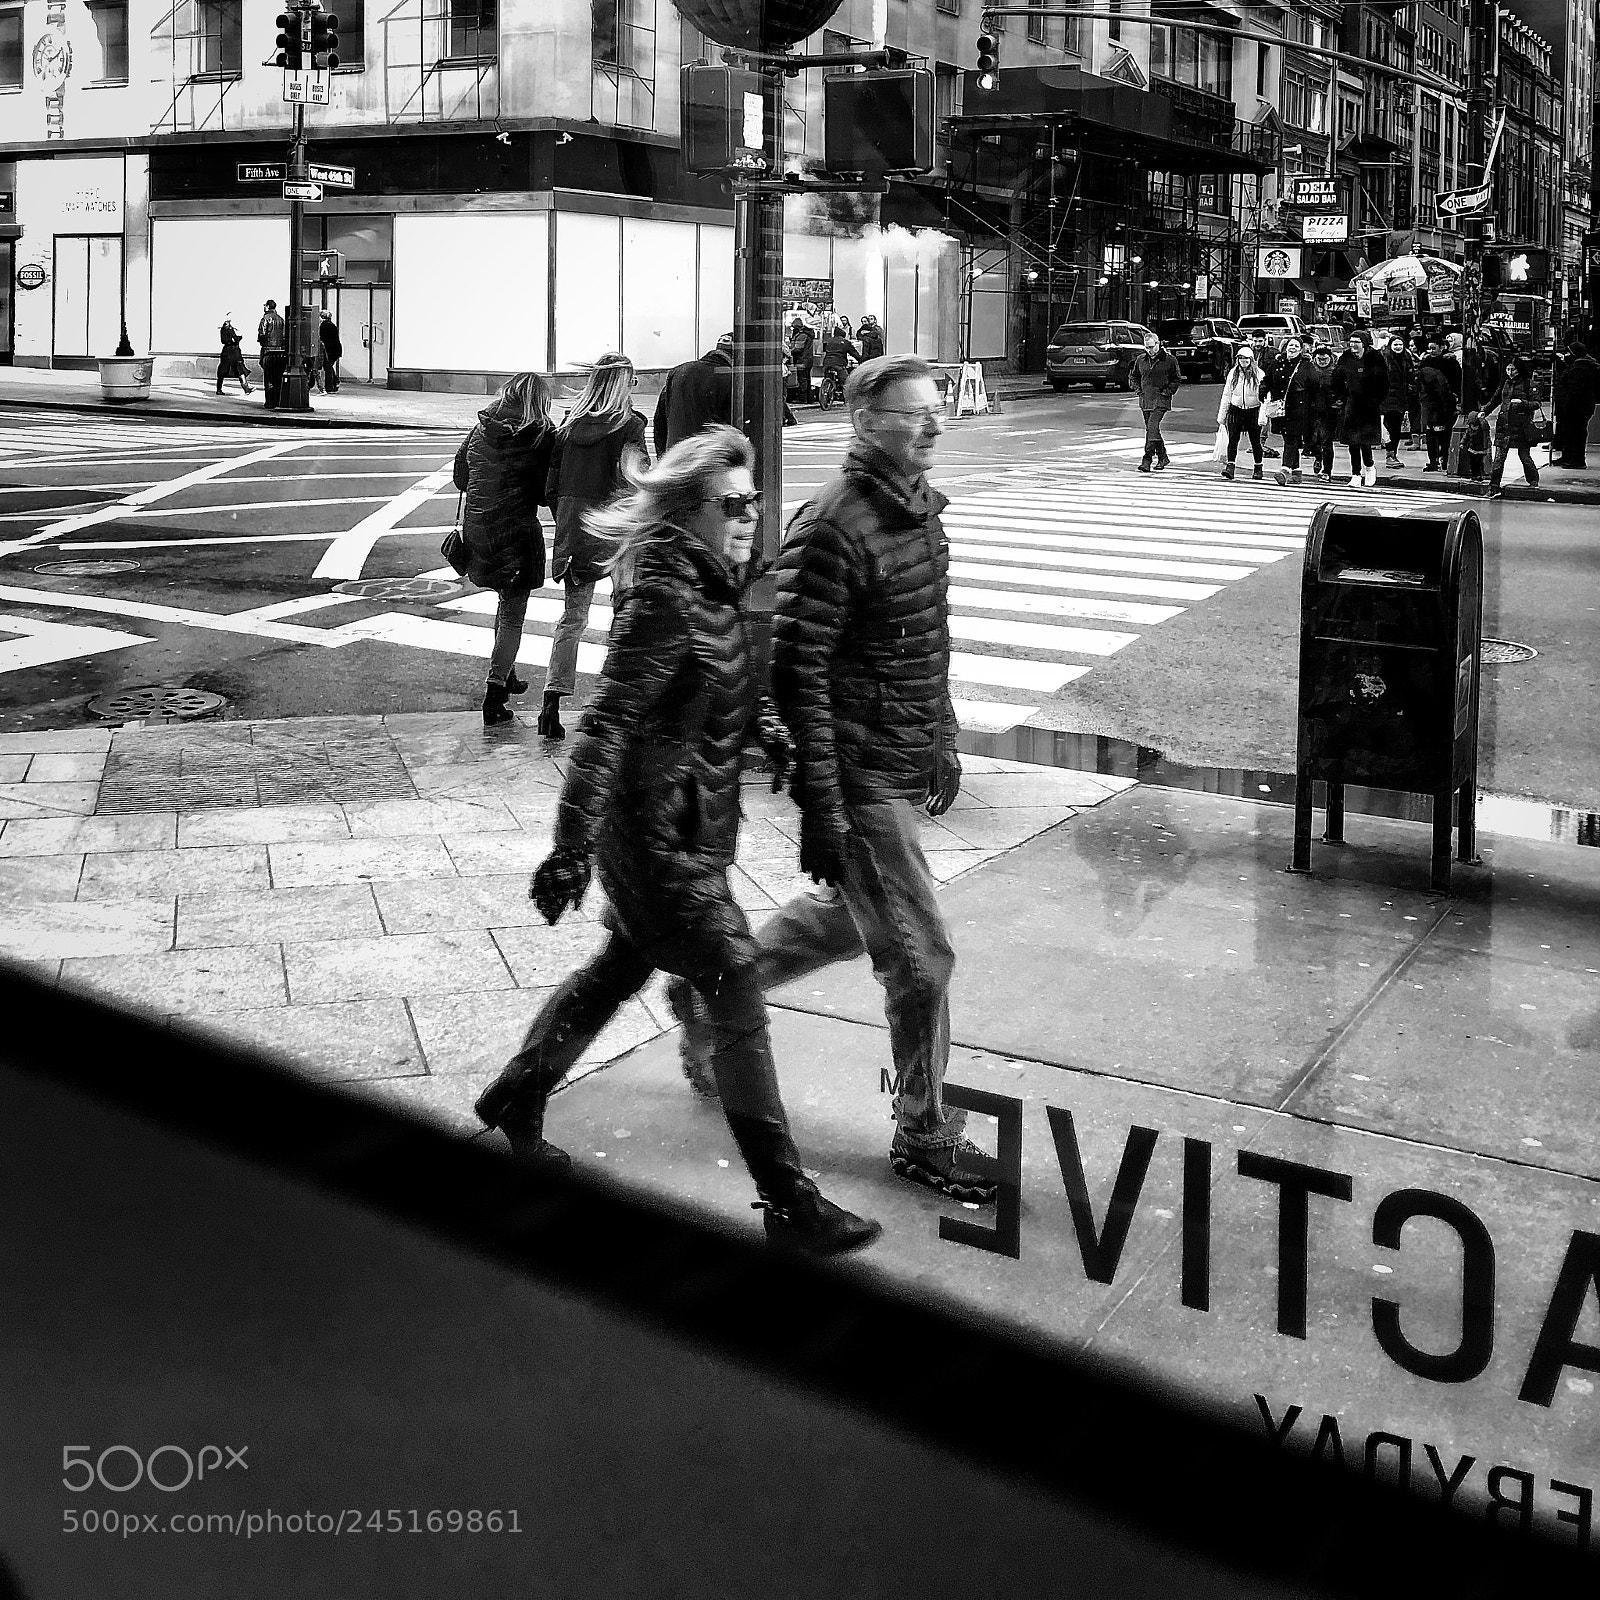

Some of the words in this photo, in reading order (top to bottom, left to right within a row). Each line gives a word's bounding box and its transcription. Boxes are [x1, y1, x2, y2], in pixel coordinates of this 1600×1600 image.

[289, 82, 302, 91] BUSES
[245, 167, 264, 178] Fifth
[264, 168, 280, 177] Ave
[310, 168, 328, 180] West
[344, 172, 352, 183] St
[286, 187, 300, 195] ONE
[1298, 181, 1335, 194] DELI
[1296, 194, 1320, 204] SALAD
[1321, 194, 1337, 204] BAR
[1446, 197, 1467, 209] ONE
[1308, 217, 1344, 226] PIZZA
[20, 271, 44, 279] FOSSIL
[1504, 321, 1530, 330] MARBLE
